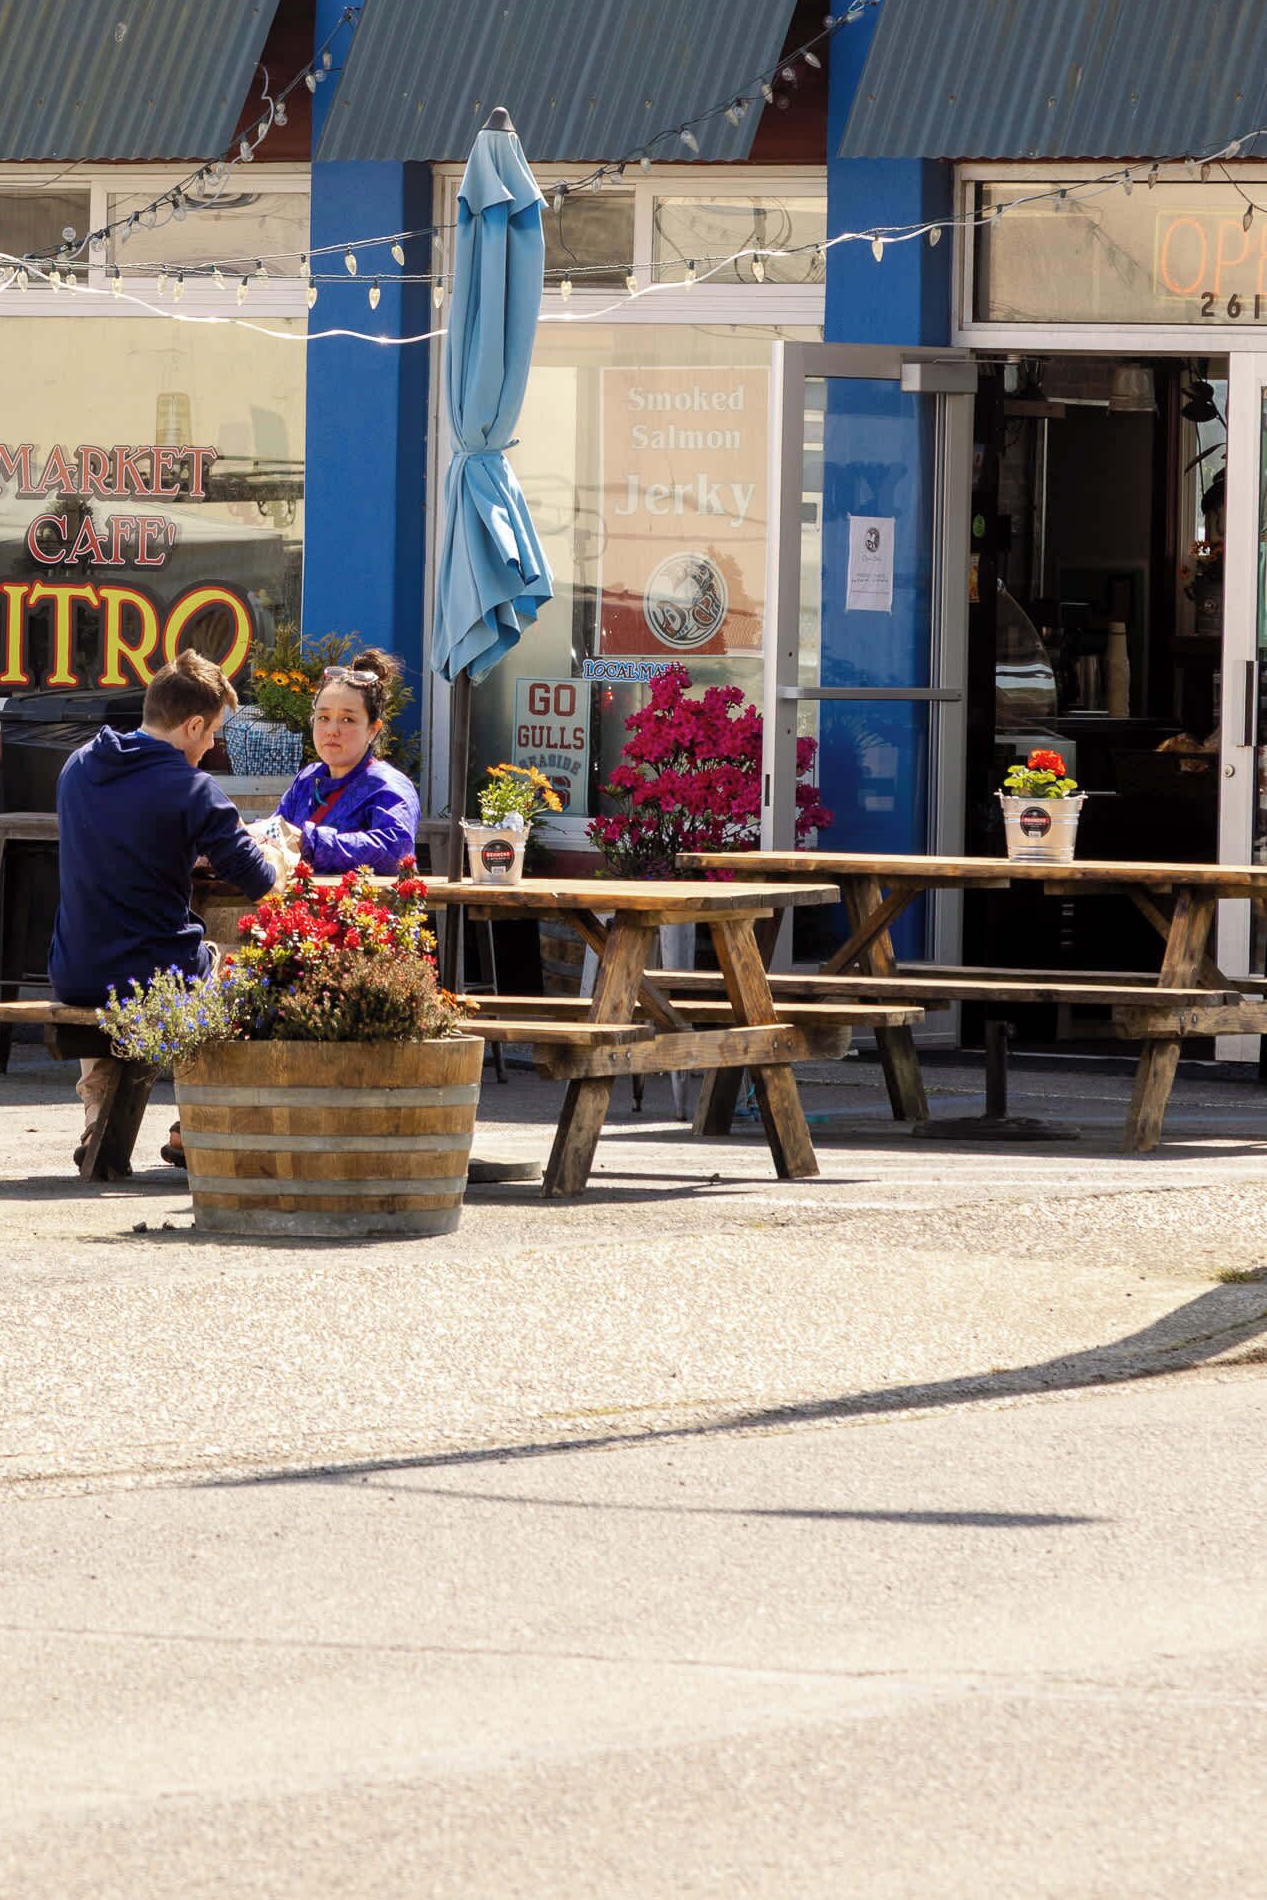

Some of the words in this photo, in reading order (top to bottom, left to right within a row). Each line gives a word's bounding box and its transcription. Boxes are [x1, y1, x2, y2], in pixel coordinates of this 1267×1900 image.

[1200, 291, 1261, 319] 261
[627, 385, 746, 412] Smoked
[632, 424, 741, 450] Salmon
[614, 472, 757, 528] Jerky
[585, 662, 636, 680] LOCAL
[529, 683, 576, 716] GO
[517, 724, 585, 750] GULLS
